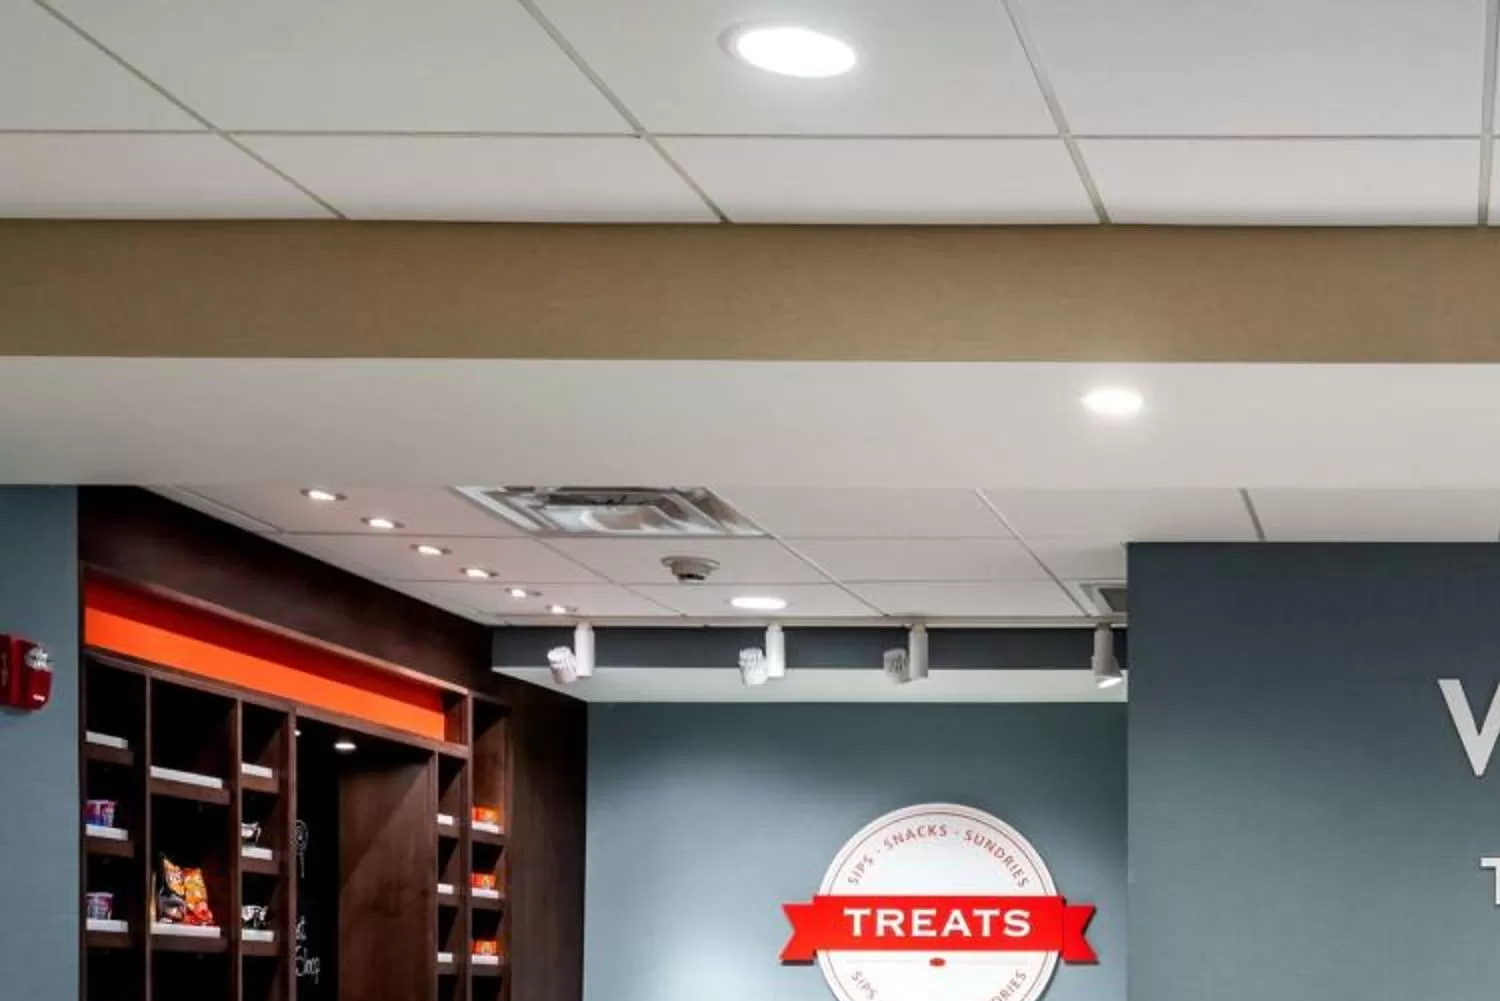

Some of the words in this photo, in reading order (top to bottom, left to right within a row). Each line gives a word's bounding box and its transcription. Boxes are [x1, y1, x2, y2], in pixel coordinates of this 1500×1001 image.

[848, 853, 874, 886] SIPS
[883, 824, 949, 850] SNACKS
[963, 829, 1030, 889] SUNDRIES
[843, 907, 1032, 938] TREATS
[851, 970, 878, 1000] SIPS
